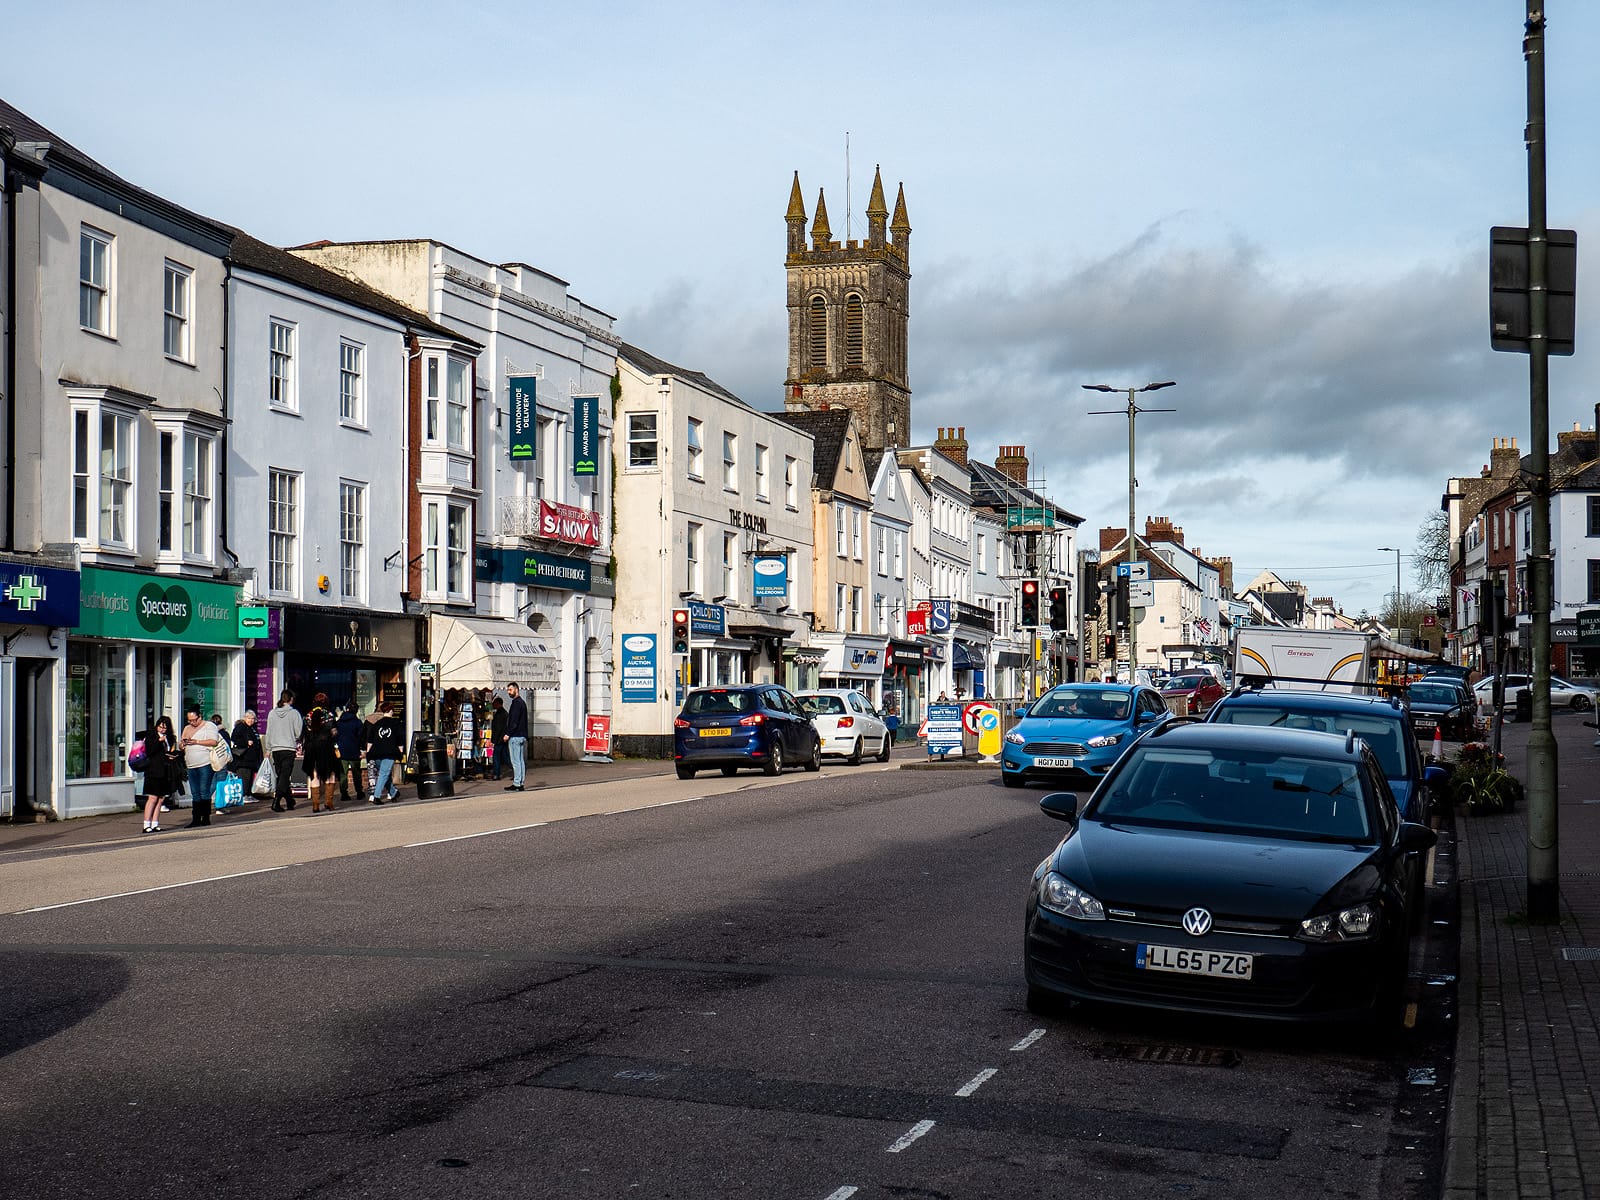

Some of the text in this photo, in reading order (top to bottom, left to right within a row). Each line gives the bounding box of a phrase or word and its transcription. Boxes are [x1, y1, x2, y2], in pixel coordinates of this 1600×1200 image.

[729, 508, 767, 534] THE DOLPHIN
[538, 563, 586, 581] PETER BETTERIDGE
[1120, 567, 1127, 576] P
[141, 595, 188, 618] Specsavers
[198, 602, 230, 621] Opticians
[692, 604, 721, 621] CHILCOTTS
[934, 601, 947, 609] WH
[933, 607, 949, 630] S
[1580, 618, 1600, 626] HOLLAN
[909, 621, 925, 634] gth
[1581, 629, 1600, 637] BARRET
[333, 634, 379, 653] DESIRE
[497, 639, 540, 655] Just Cards
[852, 649, 864, 665] Hays
[864, 650, 878, 665] Travel
[586, 730, 609, 741] SALE
[1054, 759, 1069, 767] UDJ
[1149, 946, 1250, 977] LL65 PZG
